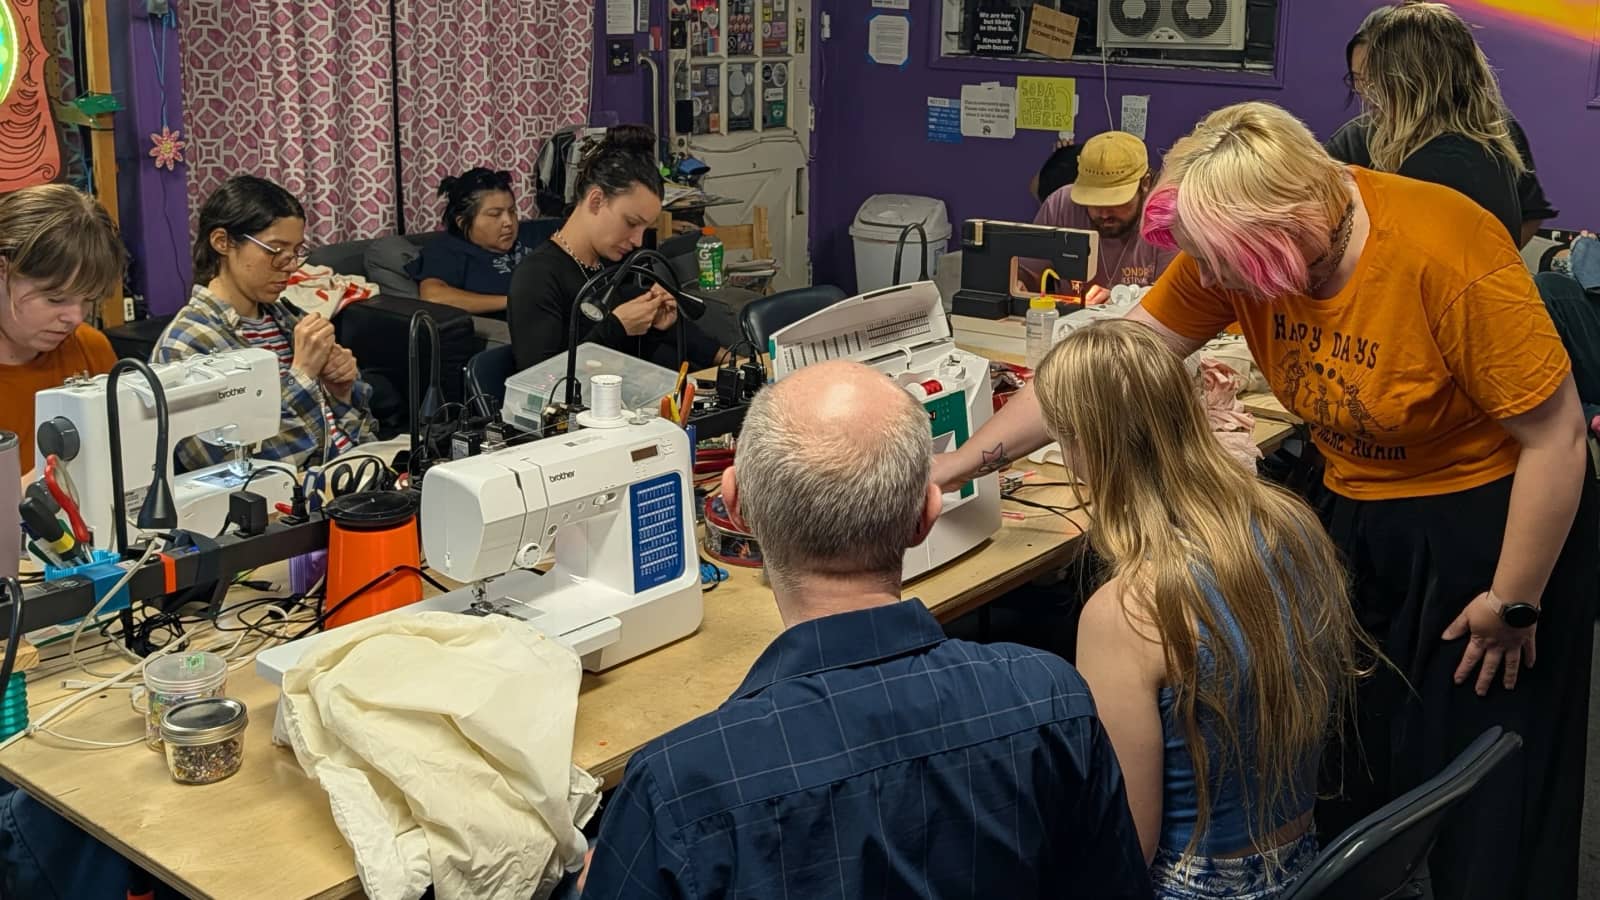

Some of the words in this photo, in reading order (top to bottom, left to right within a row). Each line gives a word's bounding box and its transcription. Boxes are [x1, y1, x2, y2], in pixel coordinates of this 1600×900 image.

[982, 36, 1001, 44] Knock
[1021, 79, 1056, 97] SODA
[1021, 110, 1063, 127] HERE
[699, 249, 711, 260] G
[1274, 314, 1322, 353] HAPY
[1331, 331, 1379, 369] DAYS
[218, 386, 246, 399] brother
[549, 470, 575, 483] brother
